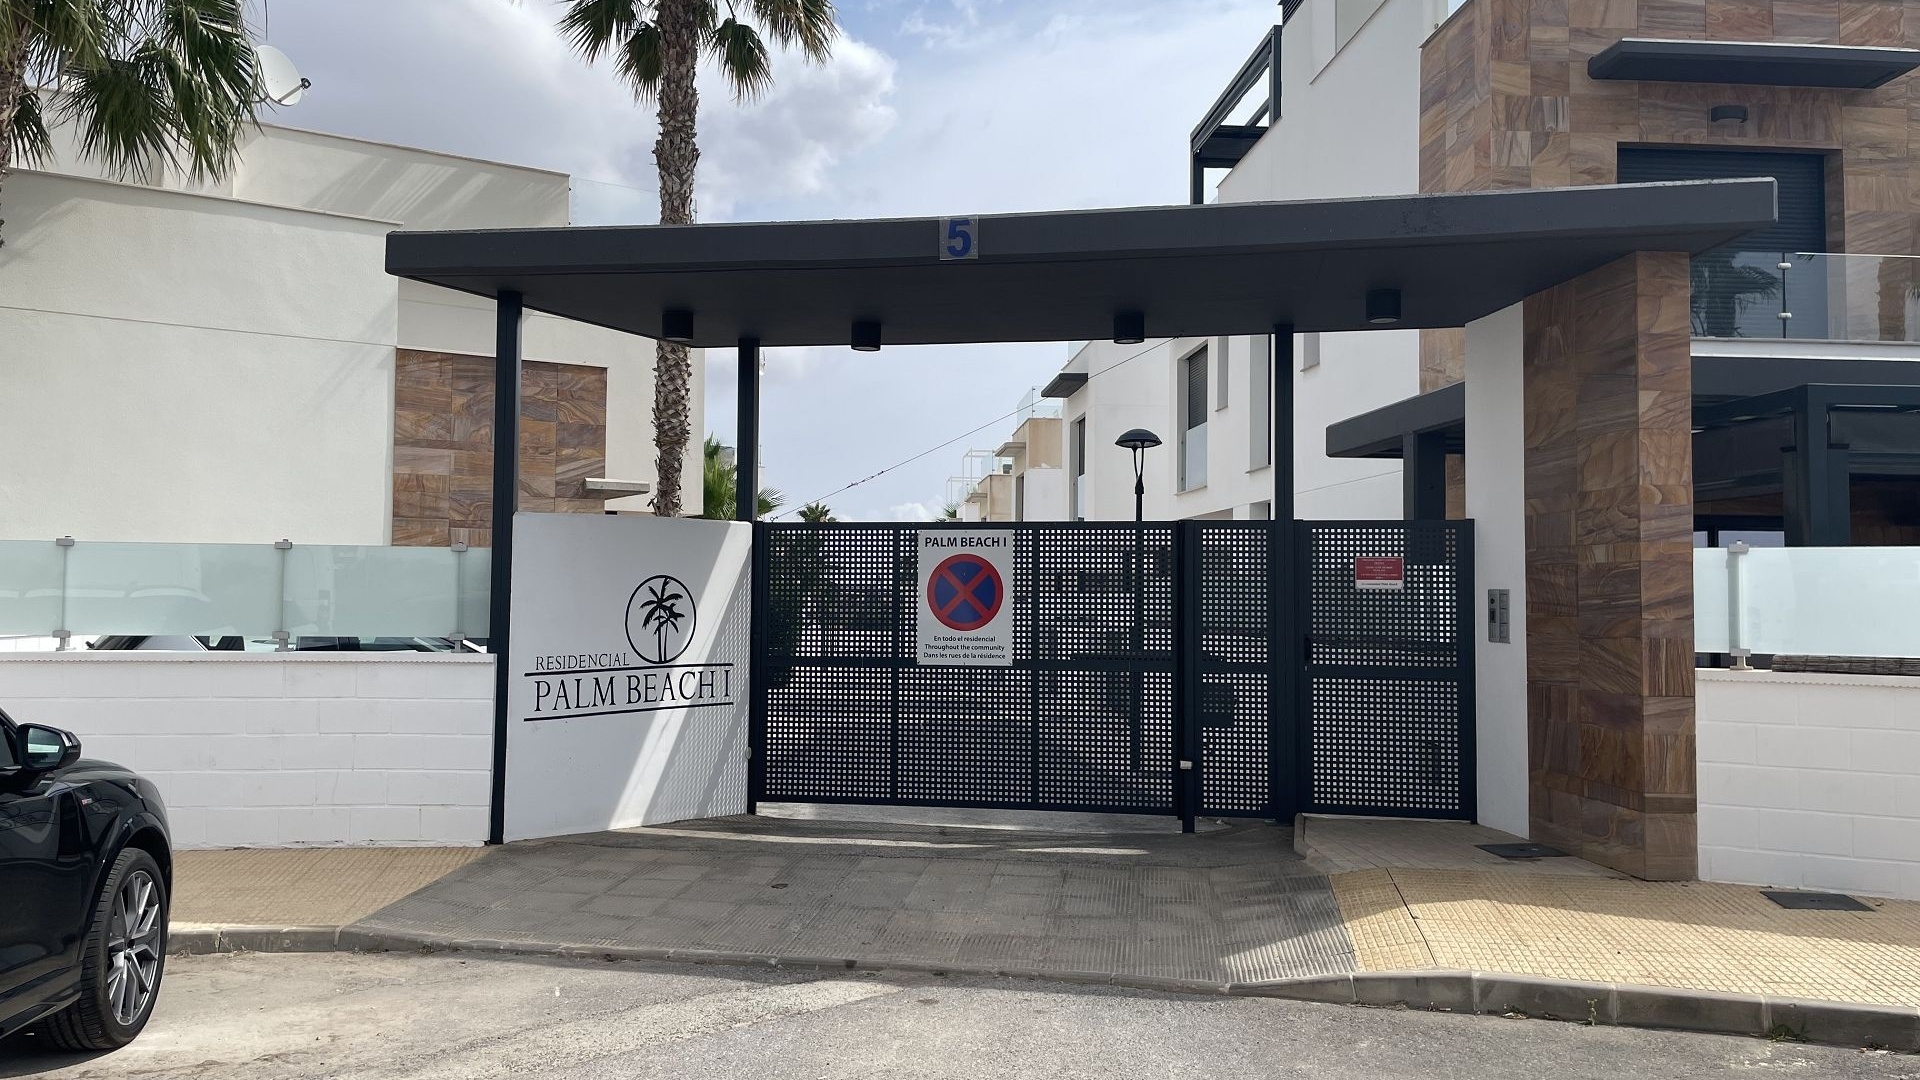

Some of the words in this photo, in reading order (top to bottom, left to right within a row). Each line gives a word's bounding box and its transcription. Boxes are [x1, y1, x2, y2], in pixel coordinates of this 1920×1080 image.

[947, 219, 971, 257] 5
[925, 537, 957, 547] PALM
[960, 537, 1000, 547] BEACH
[1003, 537, 1007, 547] I
[535, 652, 630, 671] RESIDENCIAL
[534, 676, 616, 712] PALM
[626, 670, 716, 705] BEACH
[723, 669, 731, 698] I
